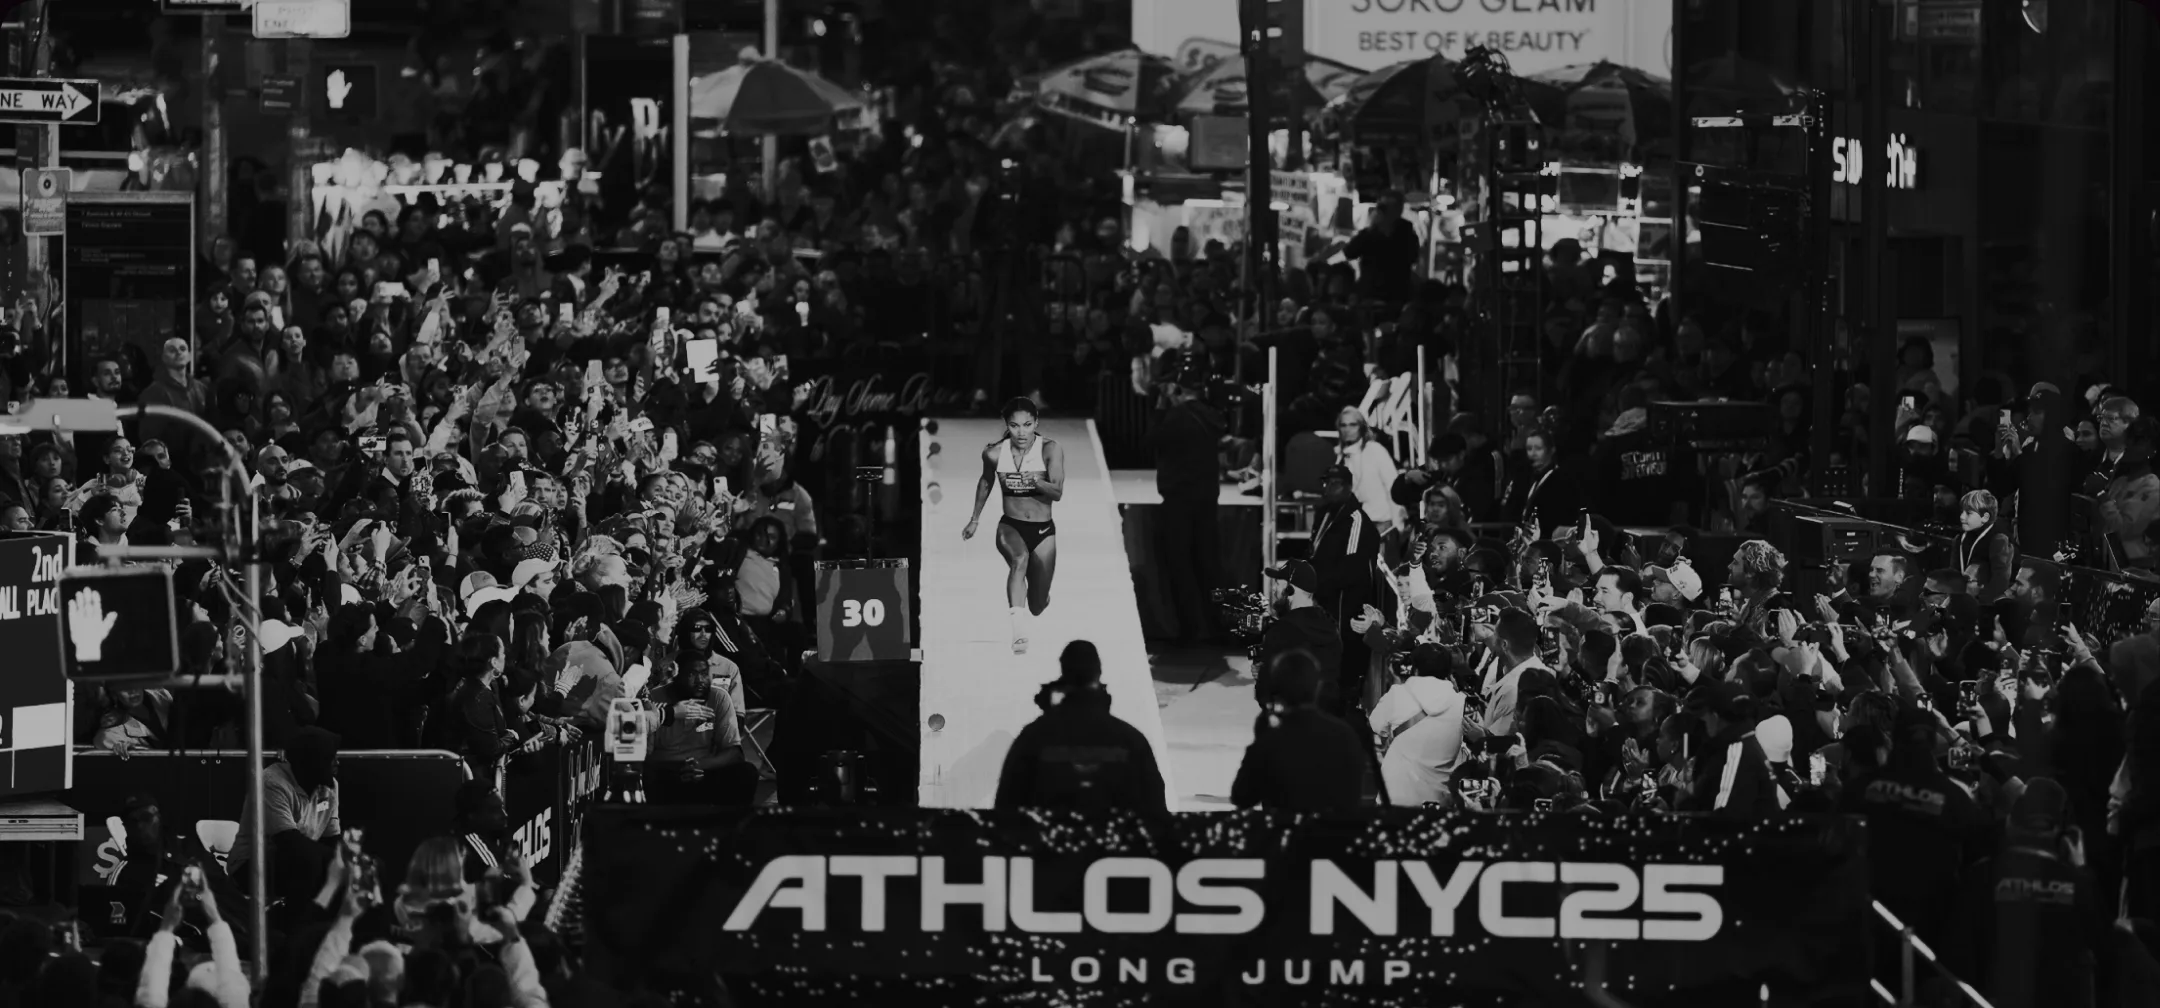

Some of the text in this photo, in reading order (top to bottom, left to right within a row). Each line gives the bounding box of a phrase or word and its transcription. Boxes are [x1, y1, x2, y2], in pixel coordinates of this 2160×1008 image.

[1359, 32, 1417, 52] BEST
[1424, 32, 1459, 52] OF
[0, 92, 78, 110] NE WAY
[31, 544, 65, 585] 2nd
[27, 585, 58, 617] PLAC
[842, 598, 885, 627] 30
[512, 806, 552, 868] THLOS
[723, 856, 1723, 940] ATHLOS NYC25
[1032, 957, 1412, 986] LONG JUMP
